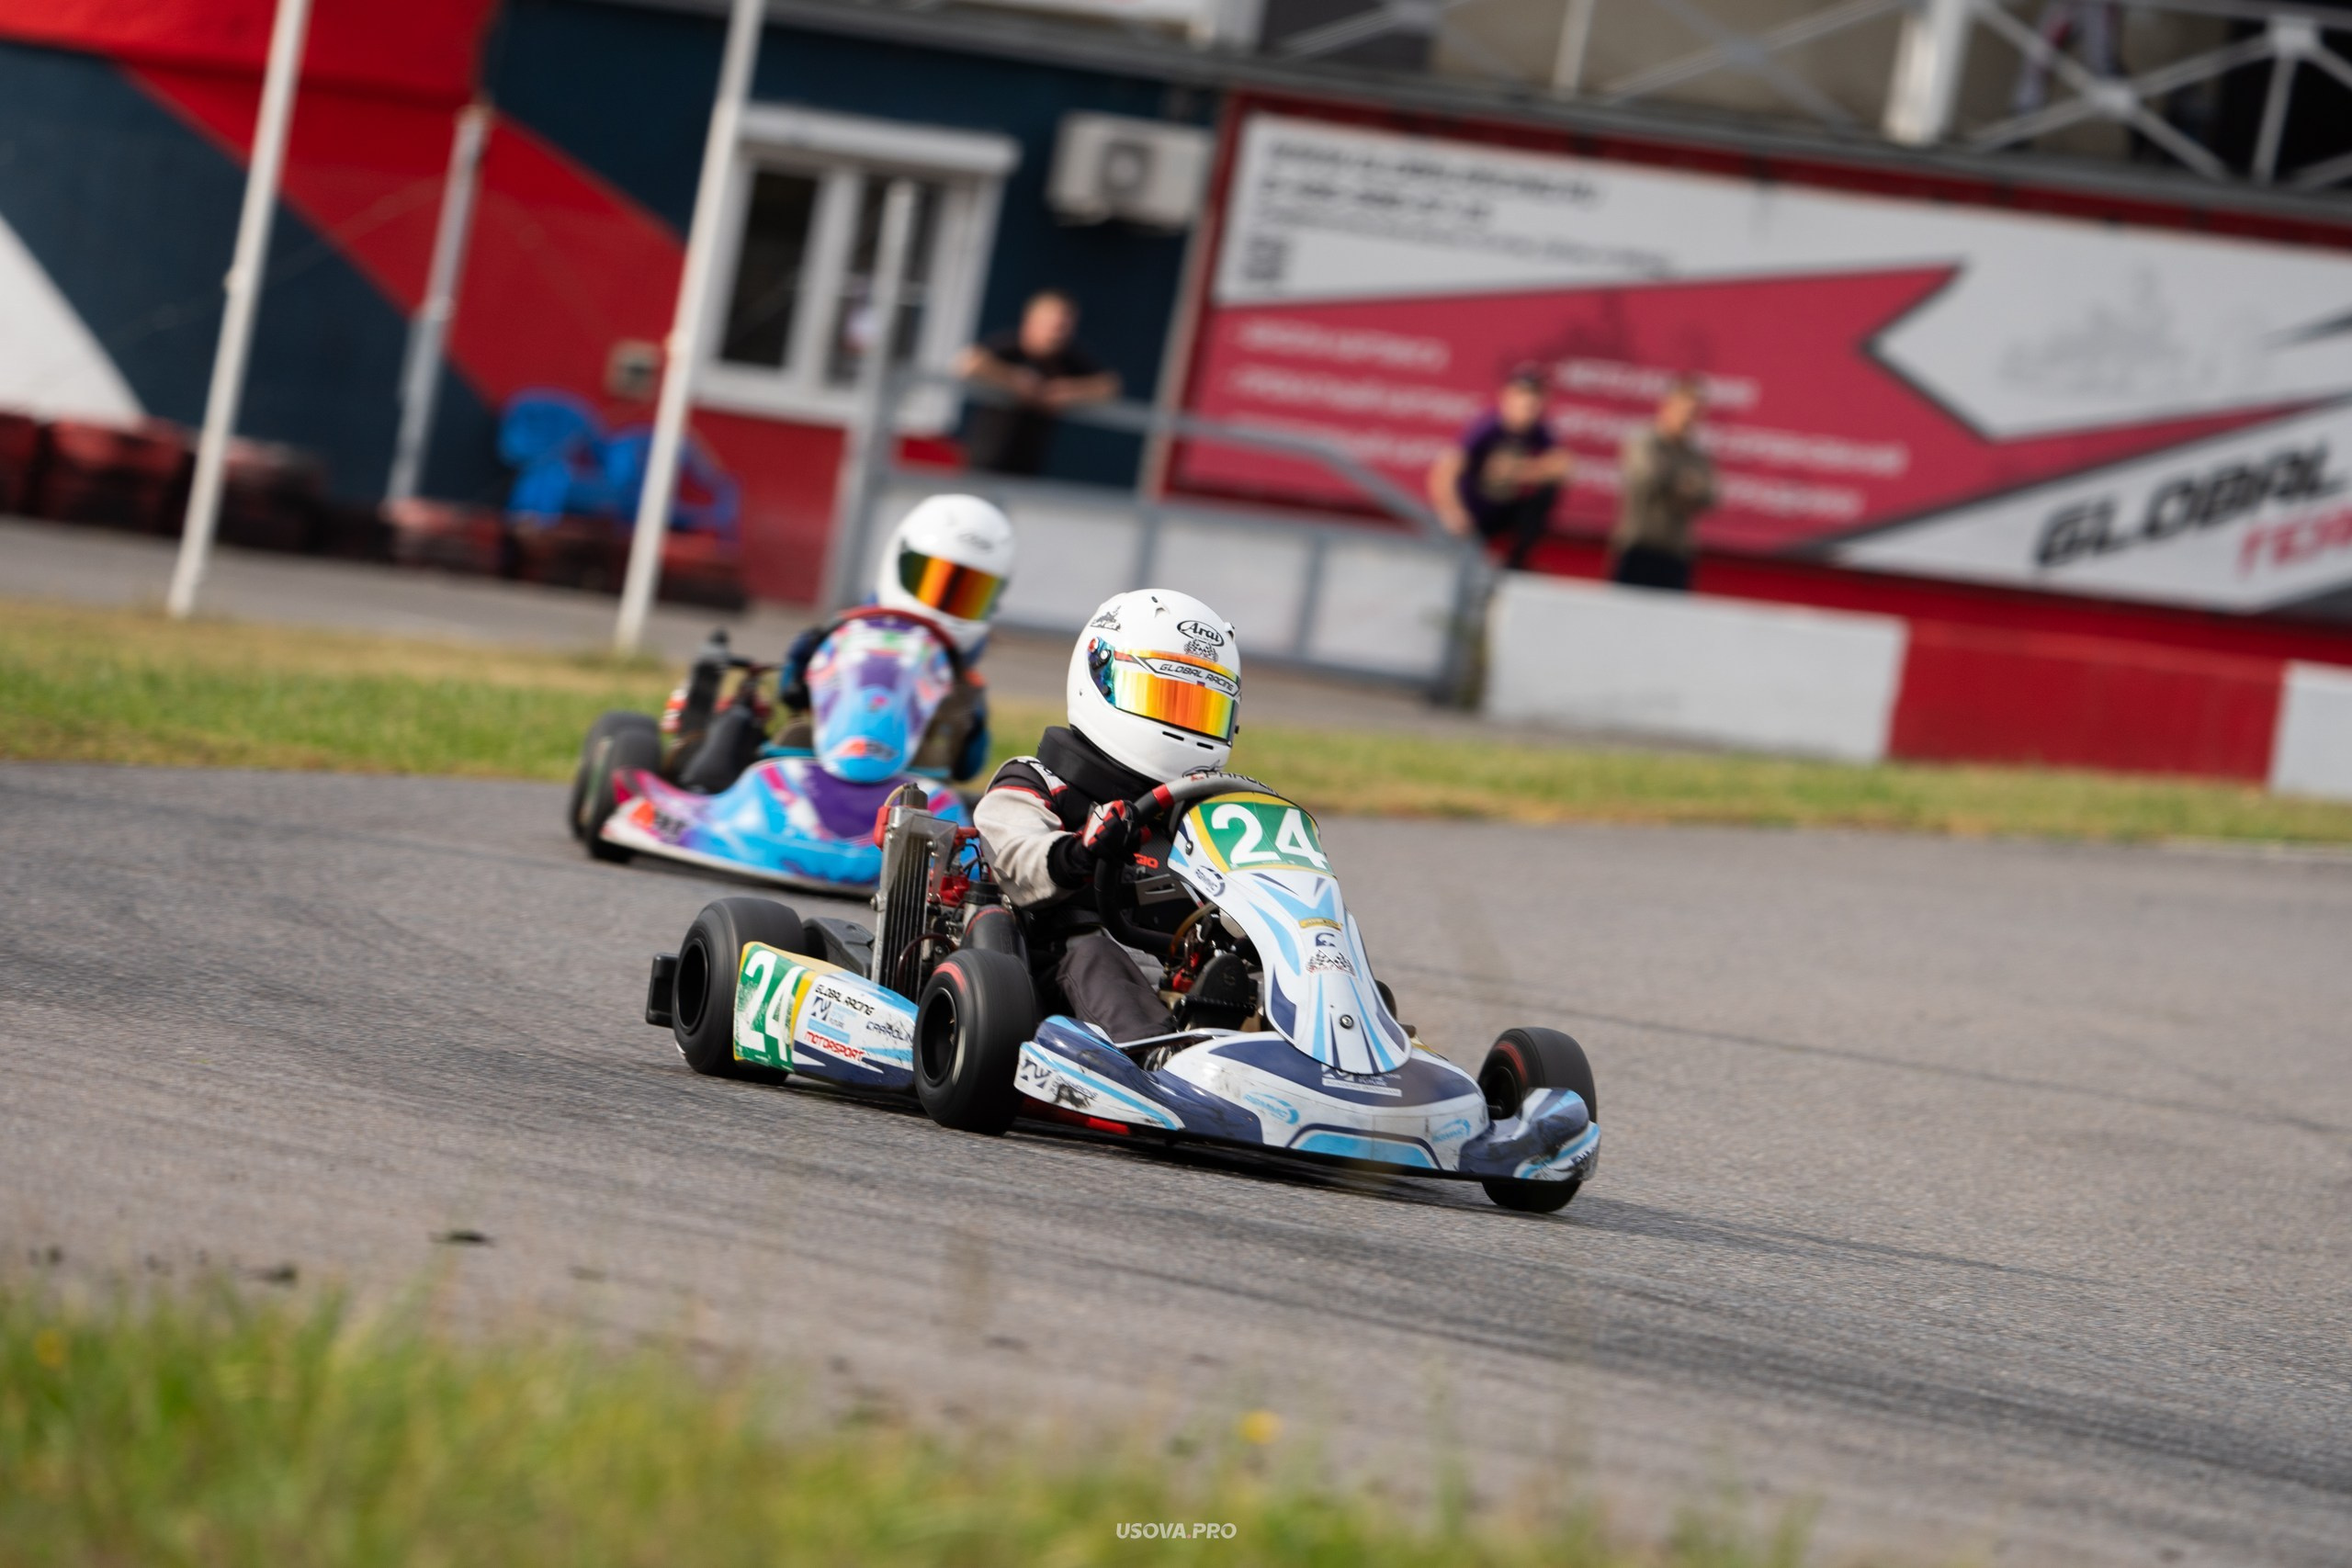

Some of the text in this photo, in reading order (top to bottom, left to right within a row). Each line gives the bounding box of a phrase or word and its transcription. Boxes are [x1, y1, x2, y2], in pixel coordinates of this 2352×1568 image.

[1181, 622, 1220, 642] Arai
[1159, 663, 1234, 692] GLOBAL RACING
[1211, 803, 1329, 870] 24
[739, 950, 807, 1062] 24
[815, 984, 876, 1016] GLOBAL RACING
[805, 1031, 865, 1062] MOTORSPORT
